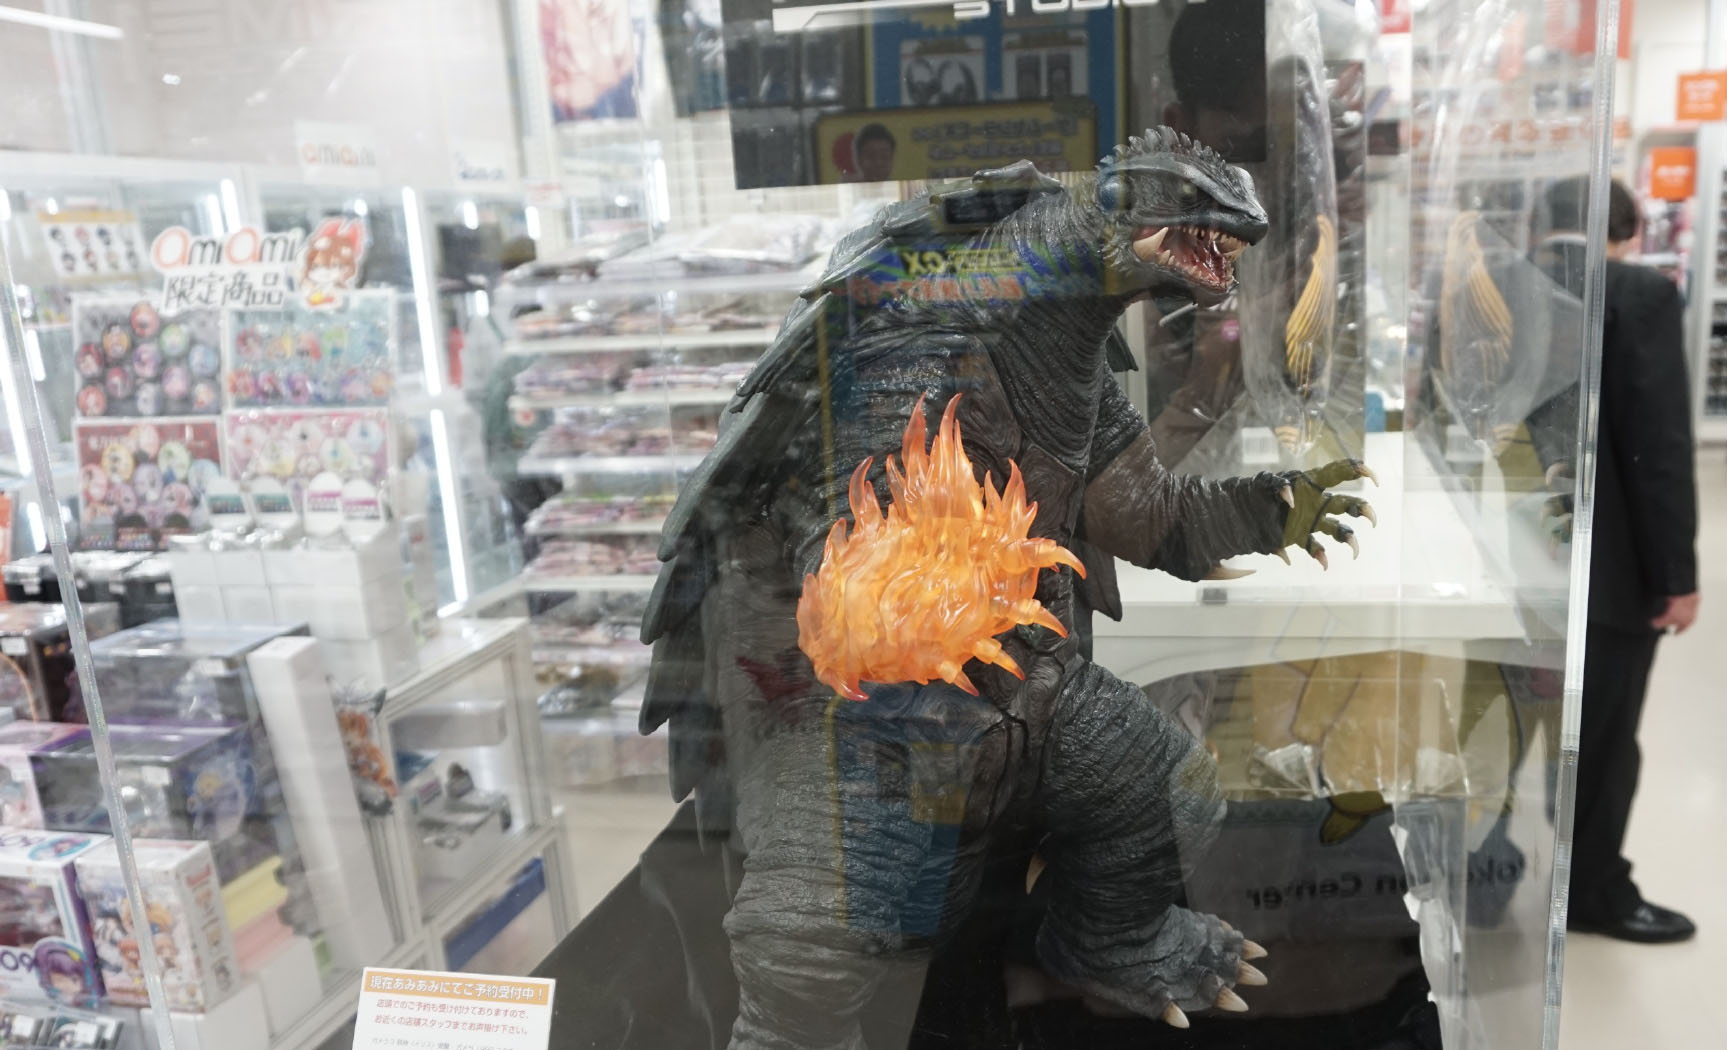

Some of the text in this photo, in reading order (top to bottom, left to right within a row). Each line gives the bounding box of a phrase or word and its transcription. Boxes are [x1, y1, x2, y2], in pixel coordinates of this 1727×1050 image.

[165, 271, 284, 308] 限定商品
[370, 975, 544, 1000] 現在あみあみにてご予約受付中！
